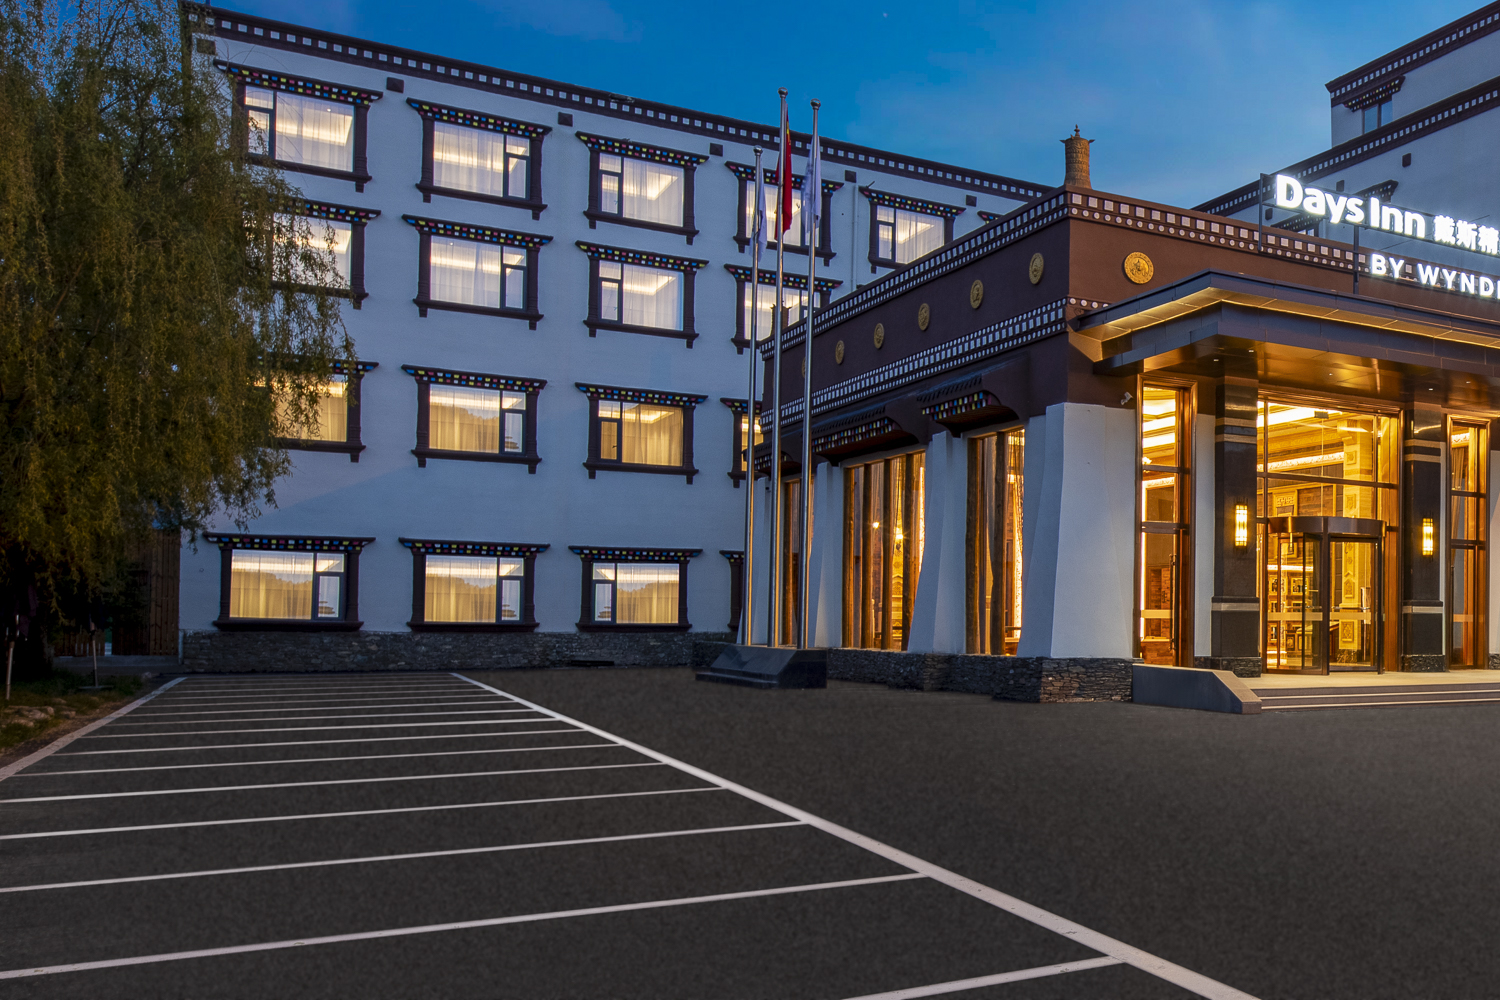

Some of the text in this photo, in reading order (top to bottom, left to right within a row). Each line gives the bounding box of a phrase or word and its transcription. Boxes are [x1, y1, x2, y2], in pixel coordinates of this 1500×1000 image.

[1276, 174, 1426, 238] Days Inn
[1371, 253, 1404, 278] BY
